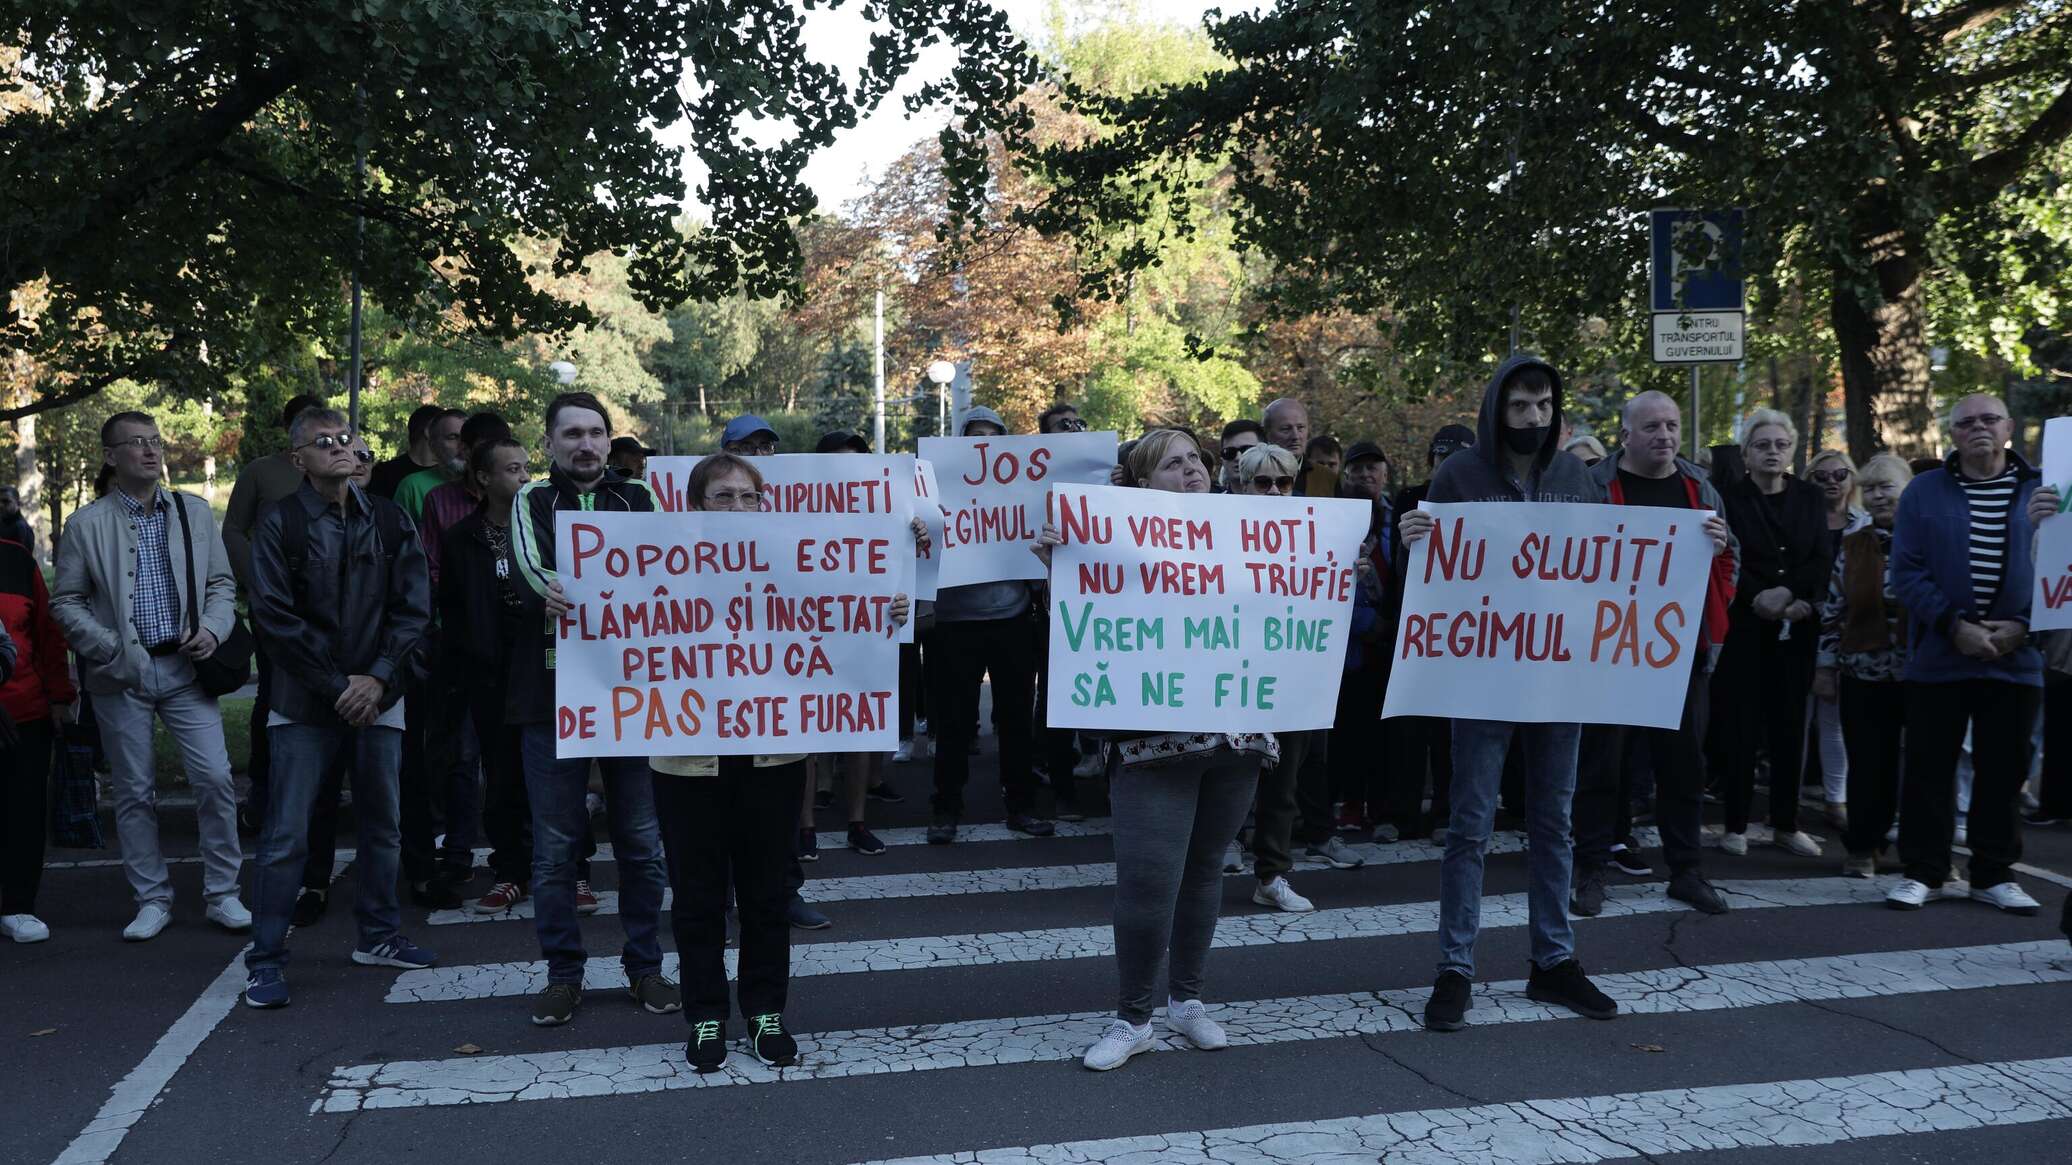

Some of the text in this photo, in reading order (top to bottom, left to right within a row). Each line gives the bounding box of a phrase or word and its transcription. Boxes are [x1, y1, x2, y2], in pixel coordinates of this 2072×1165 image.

[1660, 332, 1736, 343] TRANSPORTUL
[1677, 318, 1720, 329] PNTRU
[1666, 345, 1733, 357] GUVERNULUI
[963, 442, 1051, 486] JOS
[940, 498, 1035, 549] EGIMUL
[1060, 493, 1112, 545] NU
[1128, 516, 1213, 551] VREM
[571, 523, 770, 579] POPORUL
[796, 539, 889, 574] ESTE
[1423, 517, 1486, 584] NU
[1078, 560, 1353, 602] NU VREM TRUFIE
[559, 586, 714, 640] FLĂMÂND
[1059, 600, 1333, 653] VREM MAI BINE
[1402, 595, 1685, 669] REGIMUL PAS
[623, 637, 833, 682] PENTRU CĂ
[1071, 659, 1277, 710] SĂ NE FIE
[559, 687, 892, 742] DE PAS ESTE FURAT
